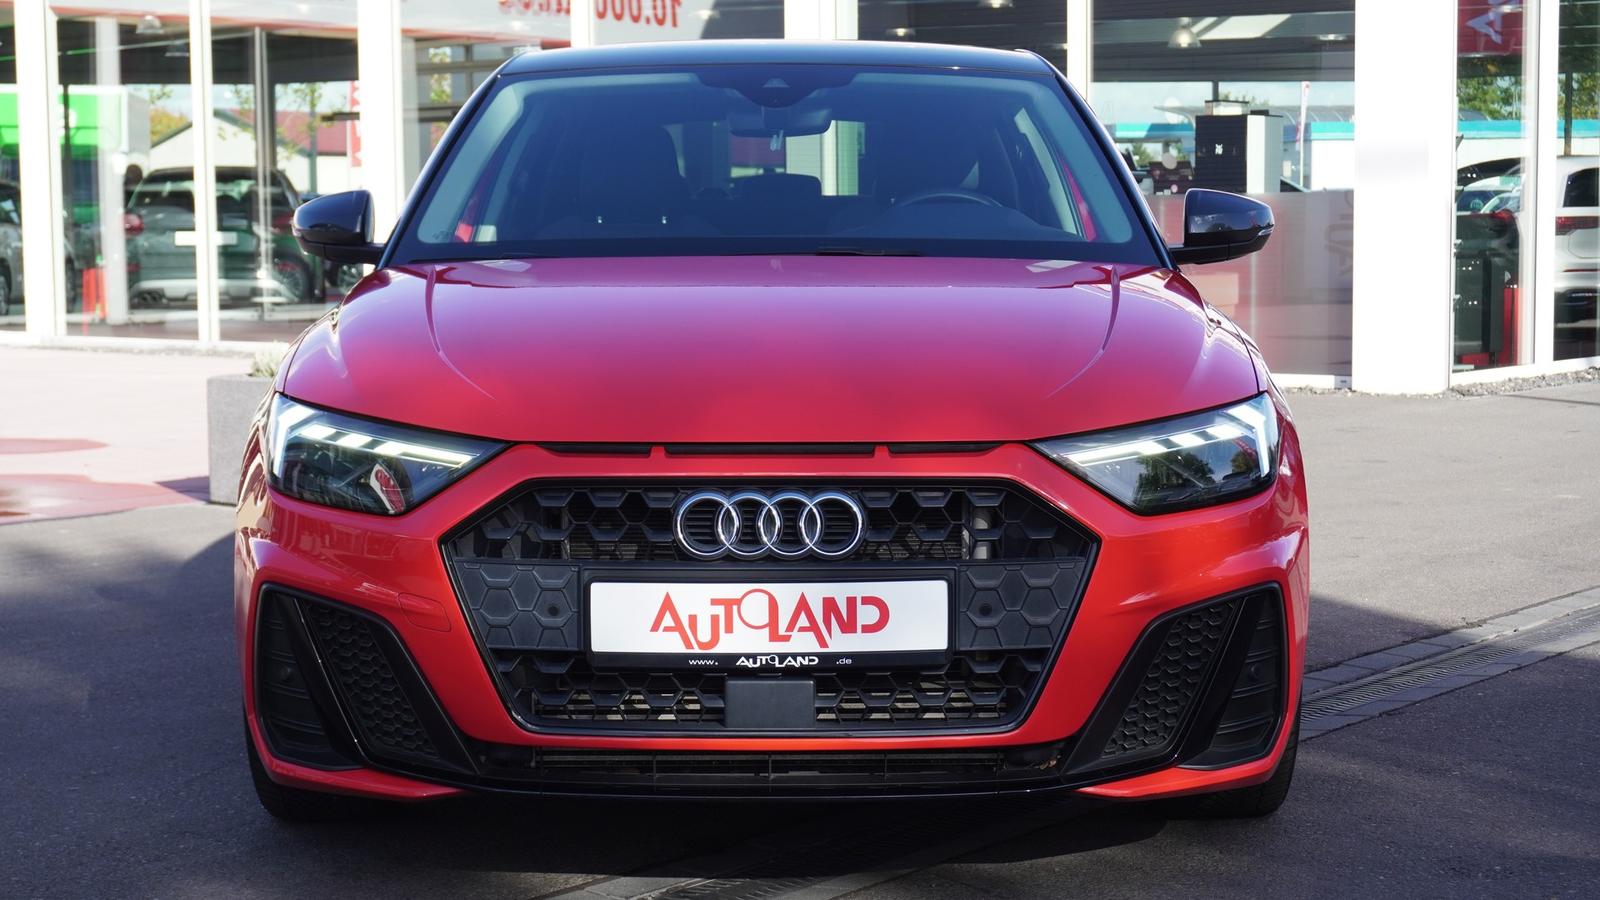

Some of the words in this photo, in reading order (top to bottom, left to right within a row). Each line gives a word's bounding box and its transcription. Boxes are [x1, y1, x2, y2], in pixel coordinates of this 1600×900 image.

[650, 588, 890, 651] AUTOLAND
[735, 654, 819, 668] AUTOLAND
[836, 657, 852, 665] .de
